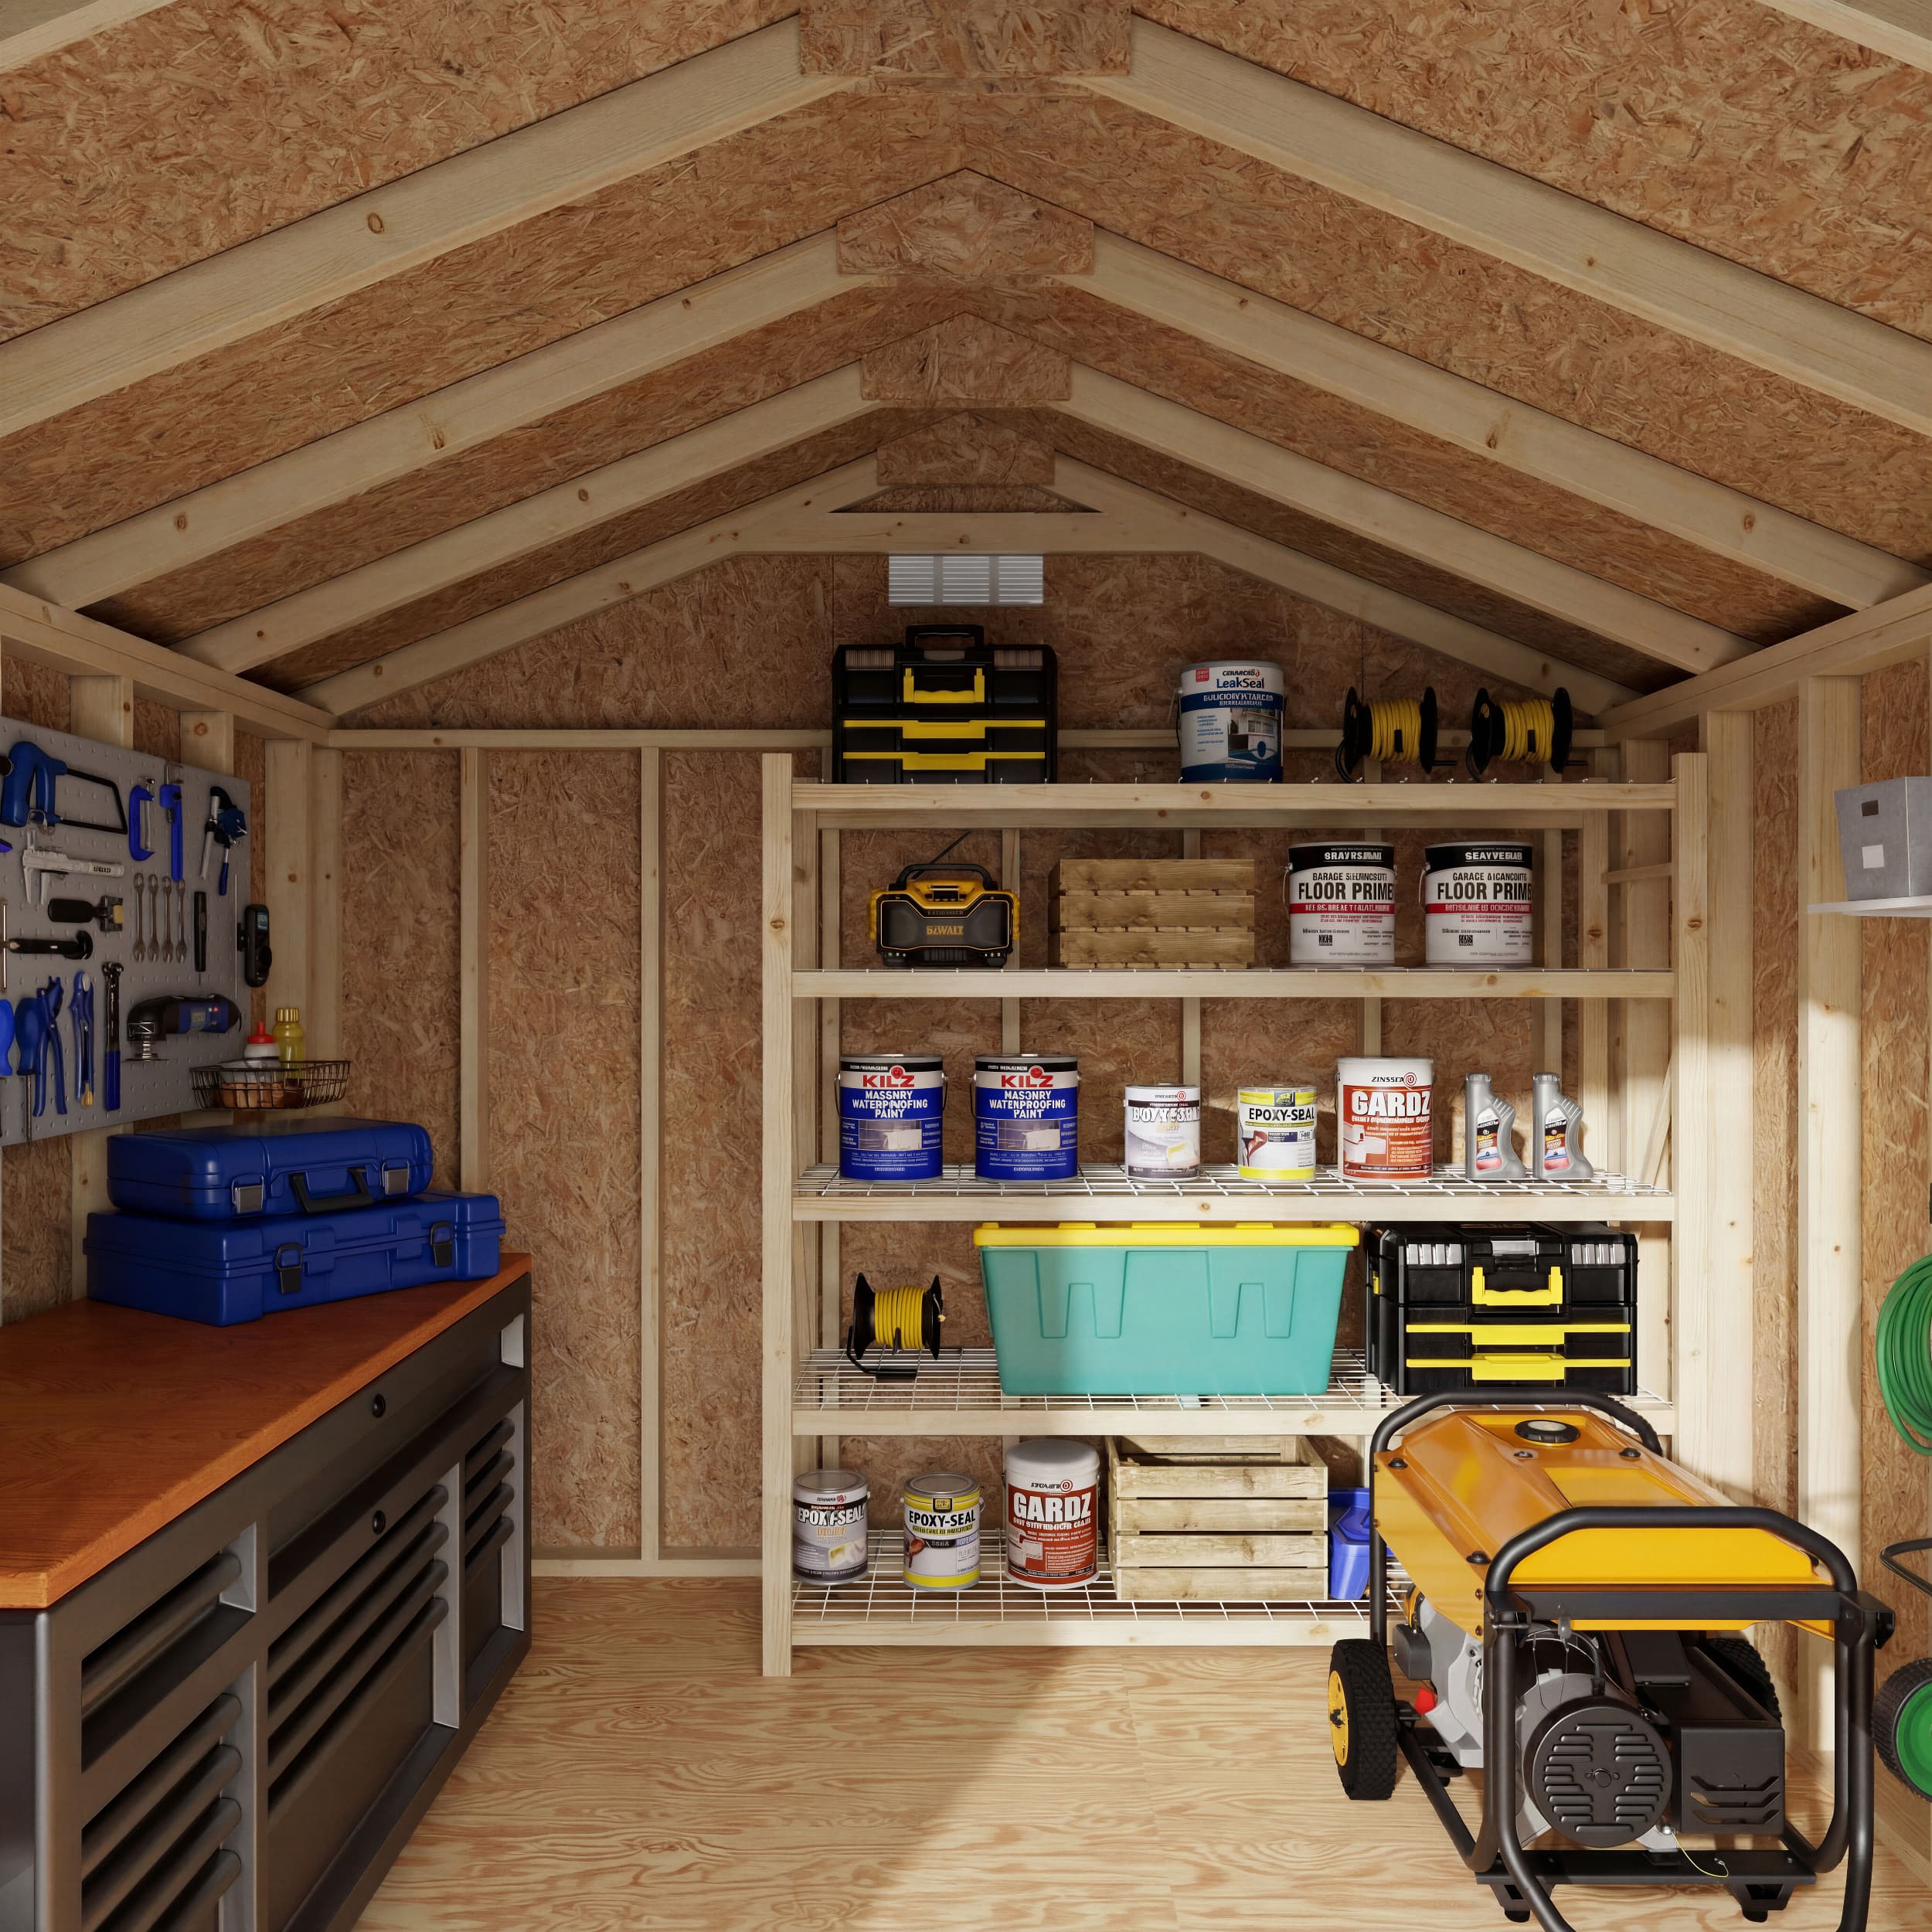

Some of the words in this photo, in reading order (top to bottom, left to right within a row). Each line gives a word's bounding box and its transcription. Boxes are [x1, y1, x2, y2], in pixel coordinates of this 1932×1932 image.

[1216, 677, 1264, 689] LeakSeal
[1298, 882, 1346, 900] FLOOR
[1437, 882, 1488, 900] FLOOR
[862, 1074, 915, 1088] KILZ
[1001, 1074, 1053, 1088] KILZ
[1012, 1109, 1045, 1118] PAINT
[1013, 1492, 1092, 1523] GARDZ
[909, 1509, 976, 1528] EPOXY-SEAL
